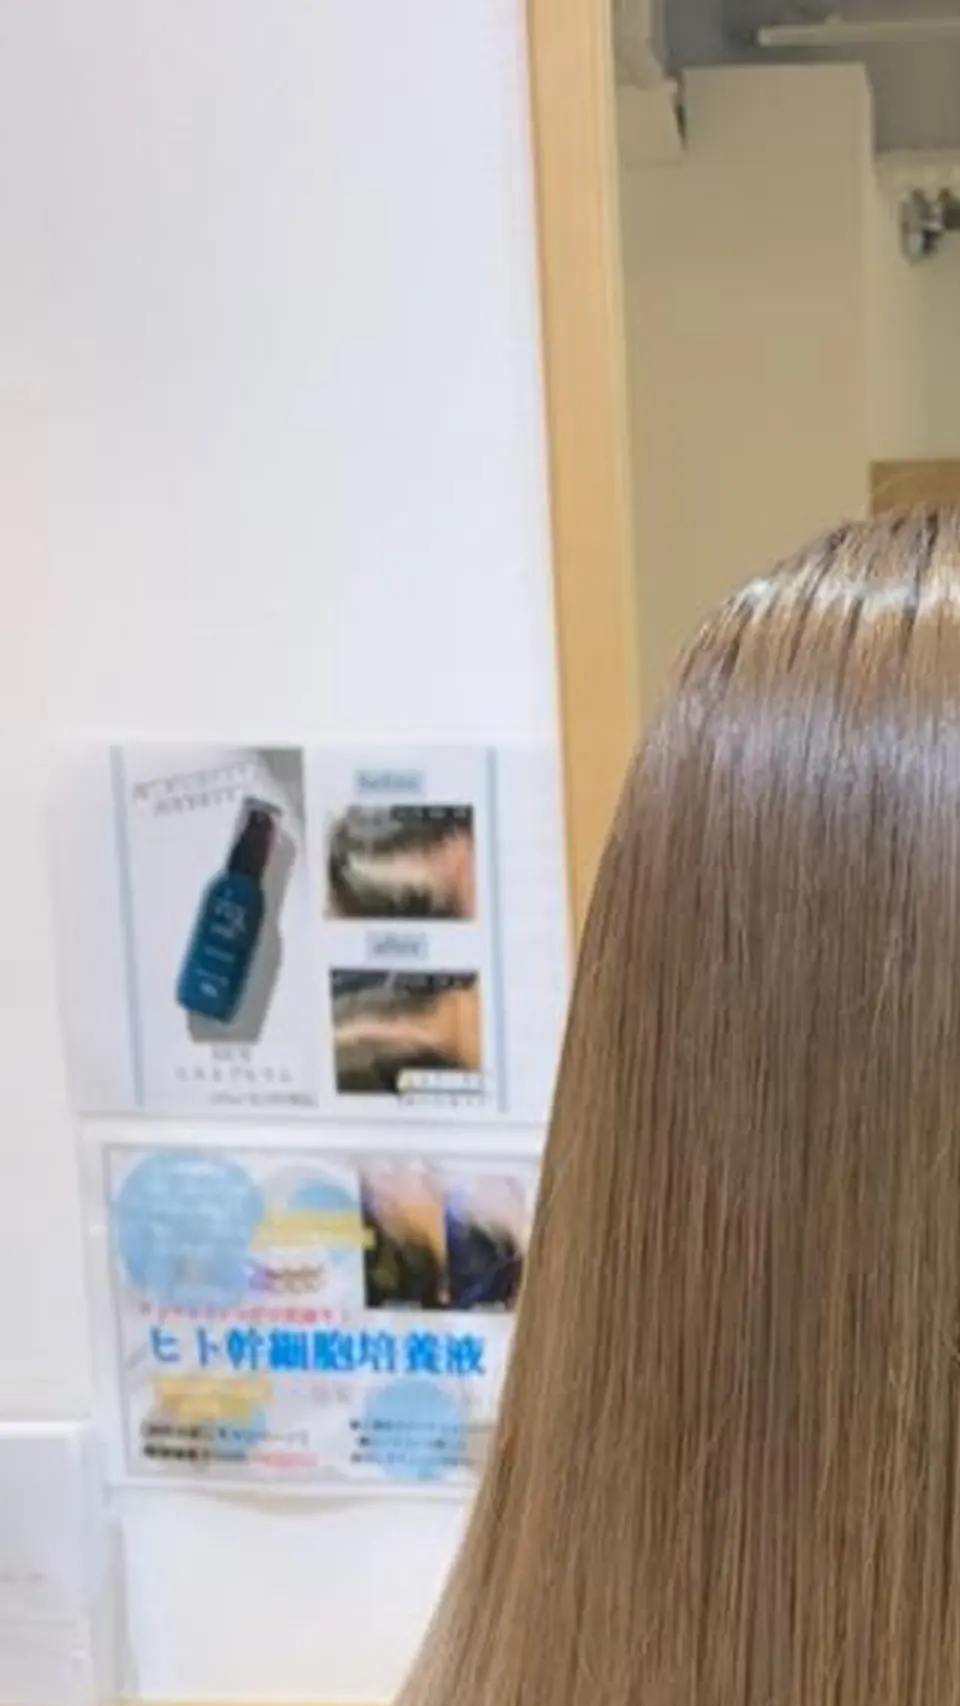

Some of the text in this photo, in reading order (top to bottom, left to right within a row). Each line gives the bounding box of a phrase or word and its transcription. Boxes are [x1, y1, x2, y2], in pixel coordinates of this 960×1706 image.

[150, 1324, 486, 1376] ヒト幹細胞培養液
